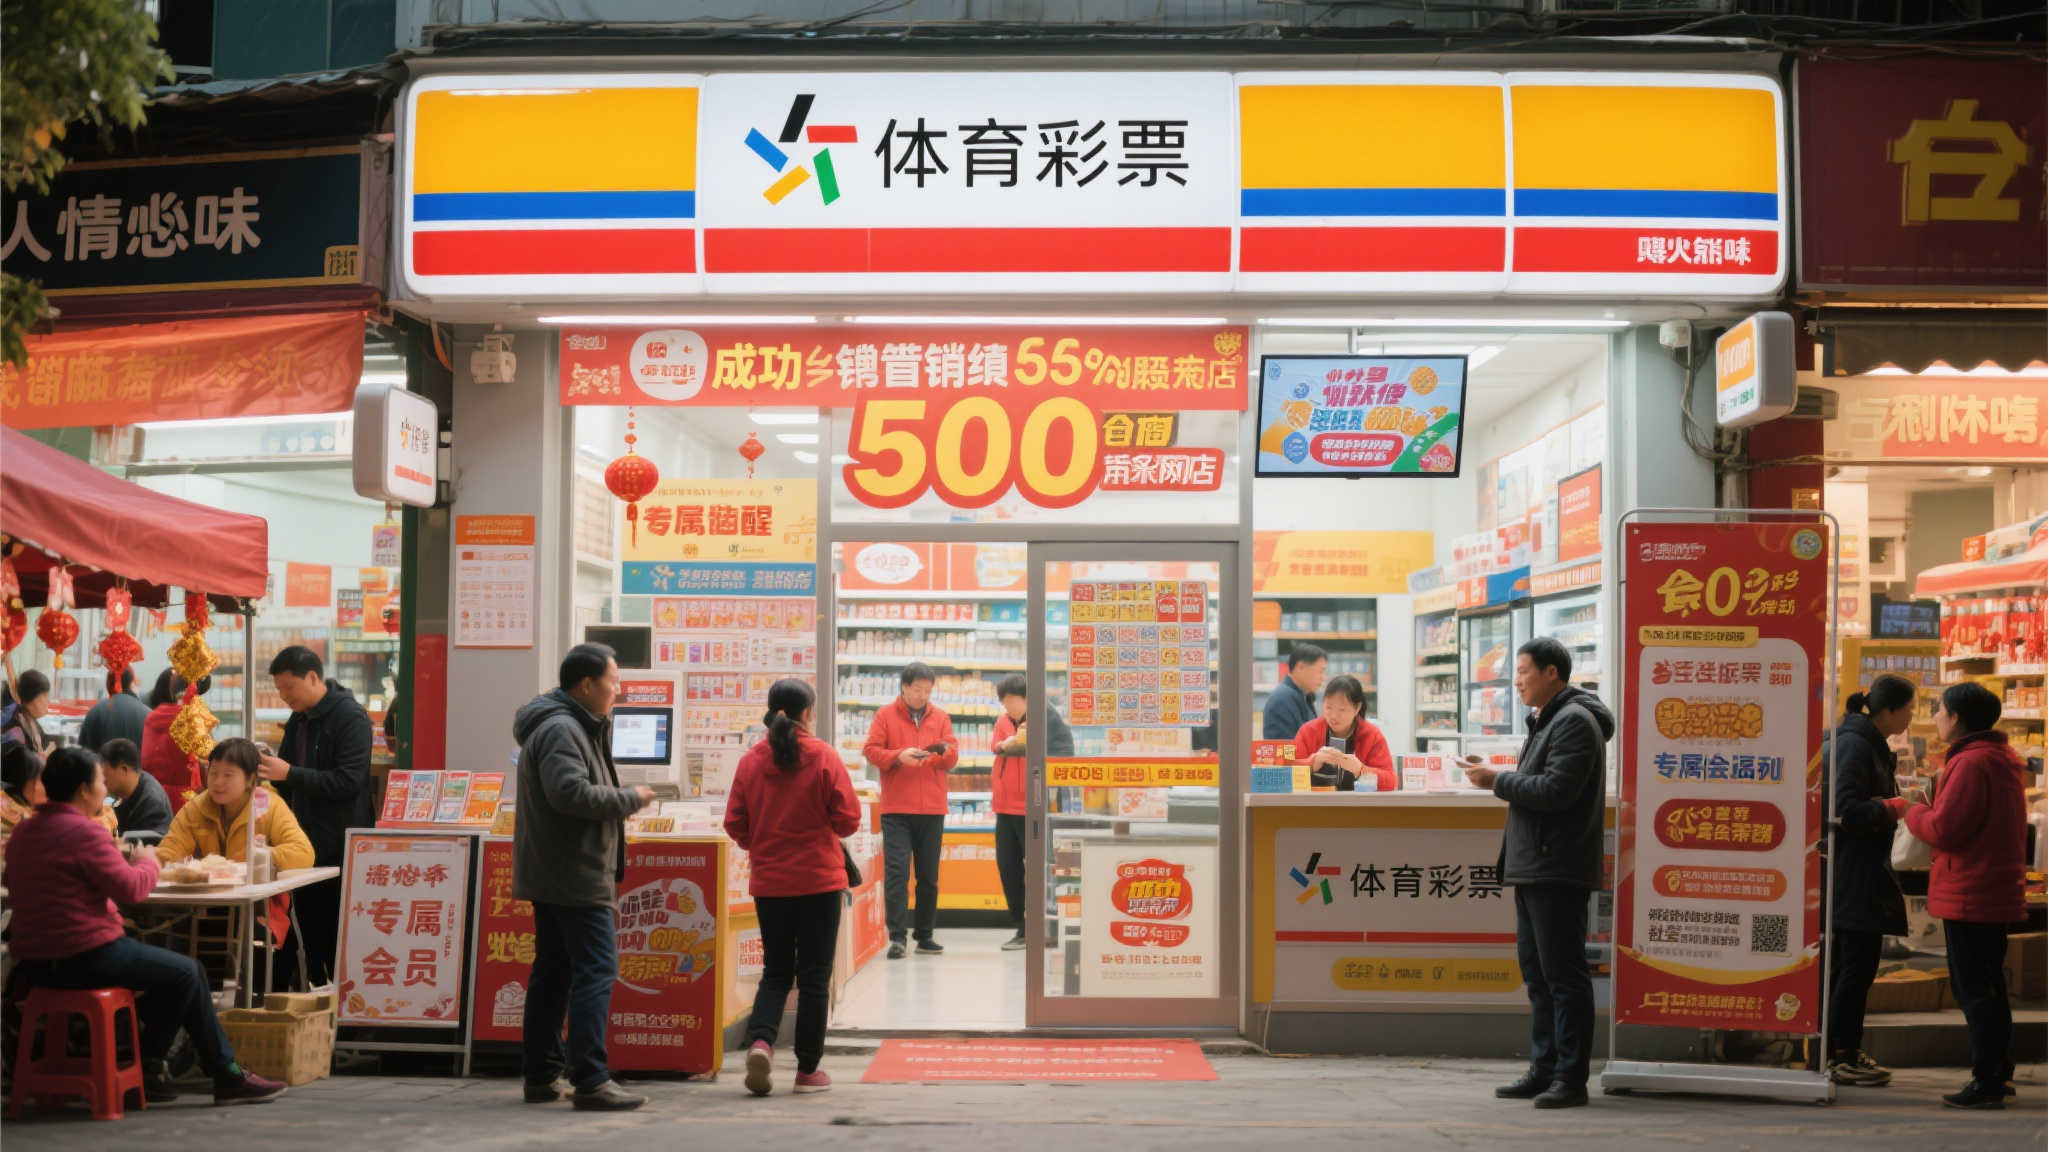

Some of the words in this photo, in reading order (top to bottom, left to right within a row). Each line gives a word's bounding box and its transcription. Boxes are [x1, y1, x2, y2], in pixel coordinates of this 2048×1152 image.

[875, 117, 1189, 188] 体育彩票
[853, 396, 1098, 497] 500
[1350, 863, 1503, 898] 体育彩票
[366, 898, 444, 937] 专属
[361, 946, 438, 987] 会员
